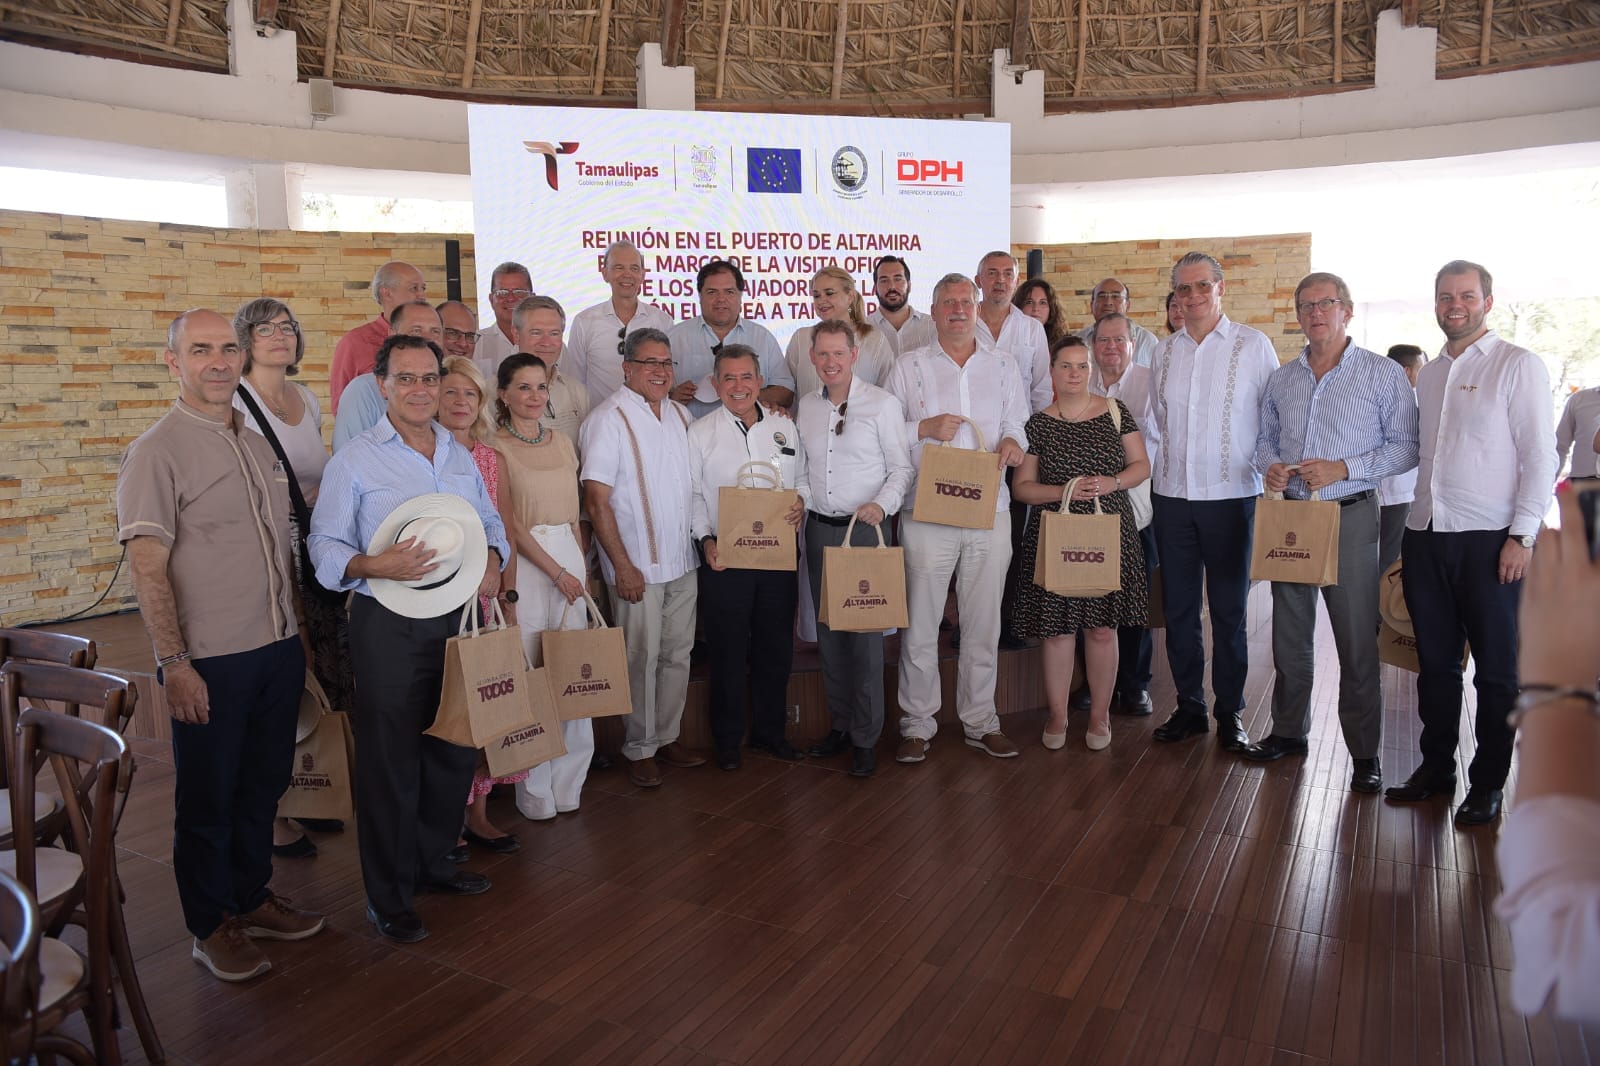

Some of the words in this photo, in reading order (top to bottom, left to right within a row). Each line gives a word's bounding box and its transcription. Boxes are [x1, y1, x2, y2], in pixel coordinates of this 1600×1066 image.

[575, 161, 659, 181] Tamaulipas
[897, 159, 963, 182] DPH
[582, 226, 670, 249] REUNIÓN
[675, 231, 700, 249] EN
[705, 232, 727, 249] EL
[732, 232, 803, 250] PUERTO
[808, 233, 831, 250] DE
[836, 233, 922, 251] ALTAMIRA
[757, 255, 780, 273] LA
[784, 255, 838, 274] VISITA
[659, 279, 694, 297] LOS
[771, 302, 784, 320] A
[934, 482, 983, 501] TODOS
[734, 537, 780, 547] ALTAMIRA
[1060, 550, 1105, 563] TODOS
[1264, 548, 1311, 560] ALTAMIRA
[842, 598, 888, 608] ALTAMIRA
[477, 678, 515, 702] TODOS
[562, 682, 612, 697] ALTAMIRA
[500, 725, 546, 749] ALTAMIRA
